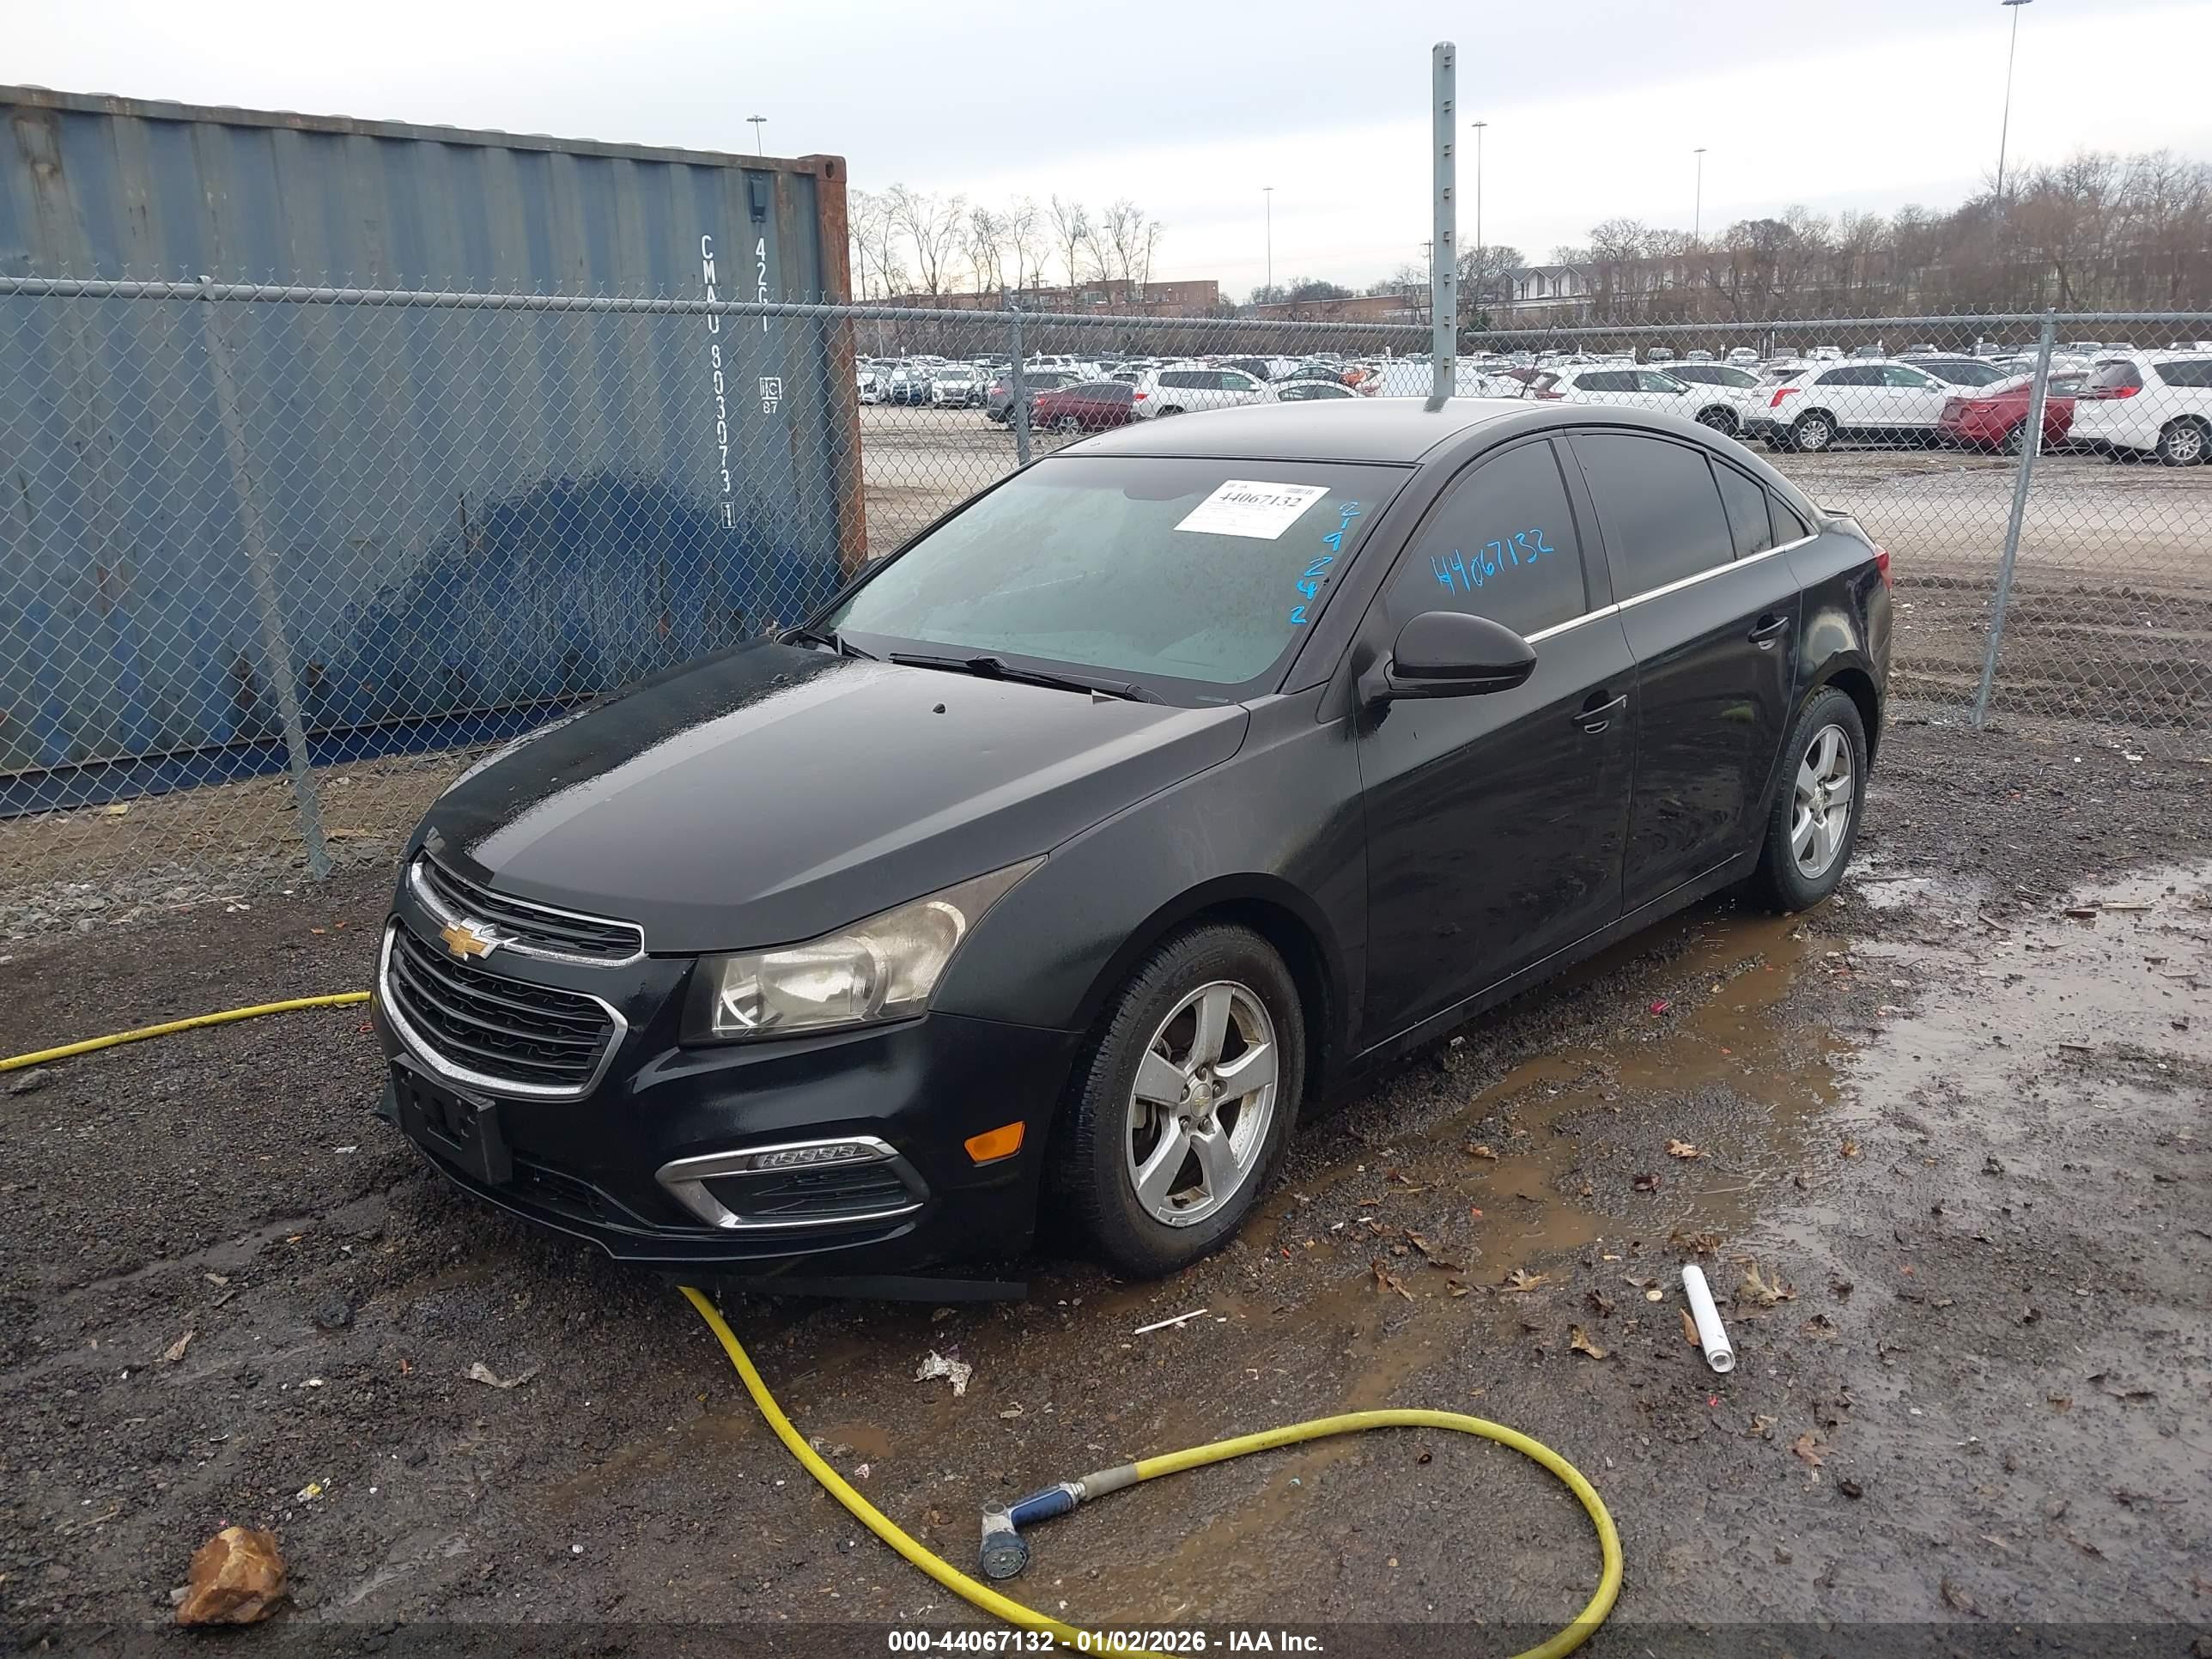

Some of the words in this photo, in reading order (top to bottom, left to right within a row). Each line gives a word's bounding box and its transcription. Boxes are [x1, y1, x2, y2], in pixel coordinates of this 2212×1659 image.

[701, 234, 720, 334] CMAU
[711, 344, 731, 493] 803073
[1218, 491, 1303, 507] 44067132
[1430, 529, 1555, 598] 44067132
